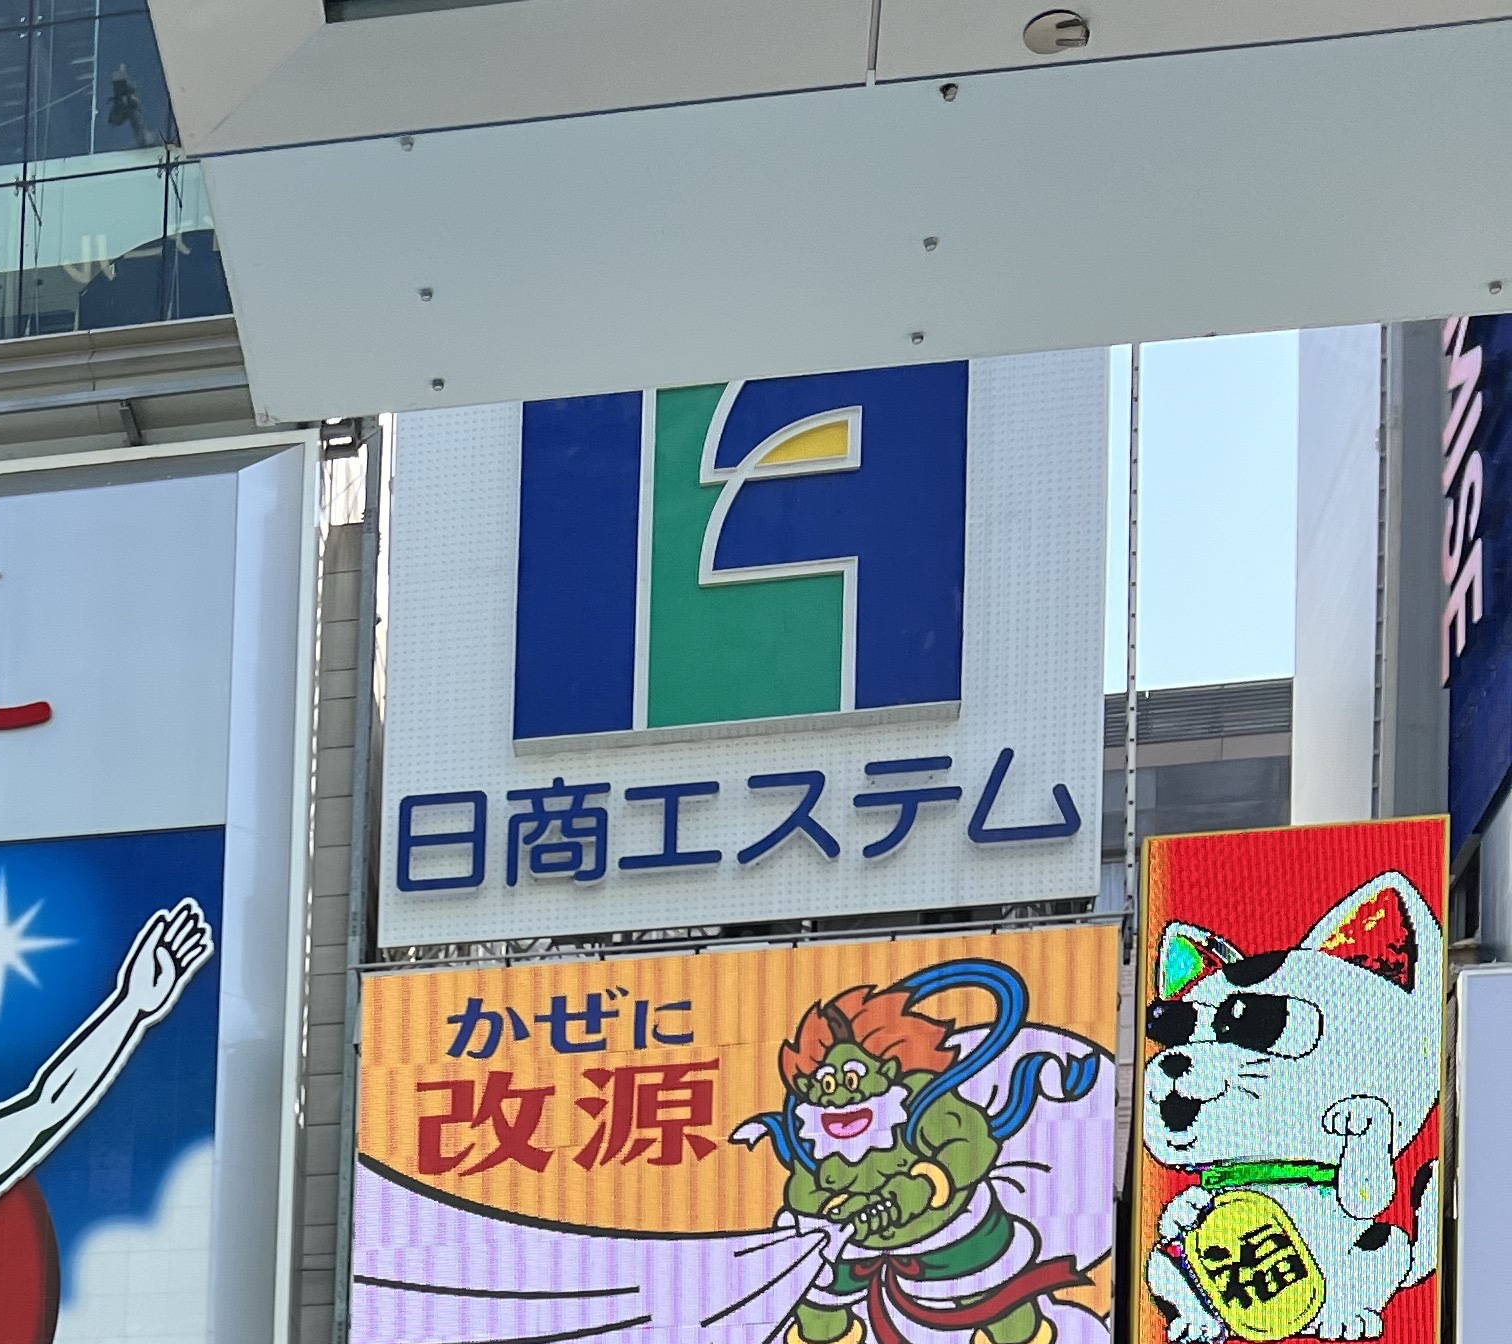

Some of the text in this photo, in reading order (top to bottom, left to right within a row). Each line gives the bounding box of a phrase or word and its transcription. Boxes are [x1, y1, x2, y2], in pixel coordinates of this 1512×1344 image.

[396, 747, 1081, 893] 日商エステム
[446, 986, 696, 1060] かぜに
[416, 1056, 720, 1177] 改源
[1203, 1222, 1307, 1309] 福
